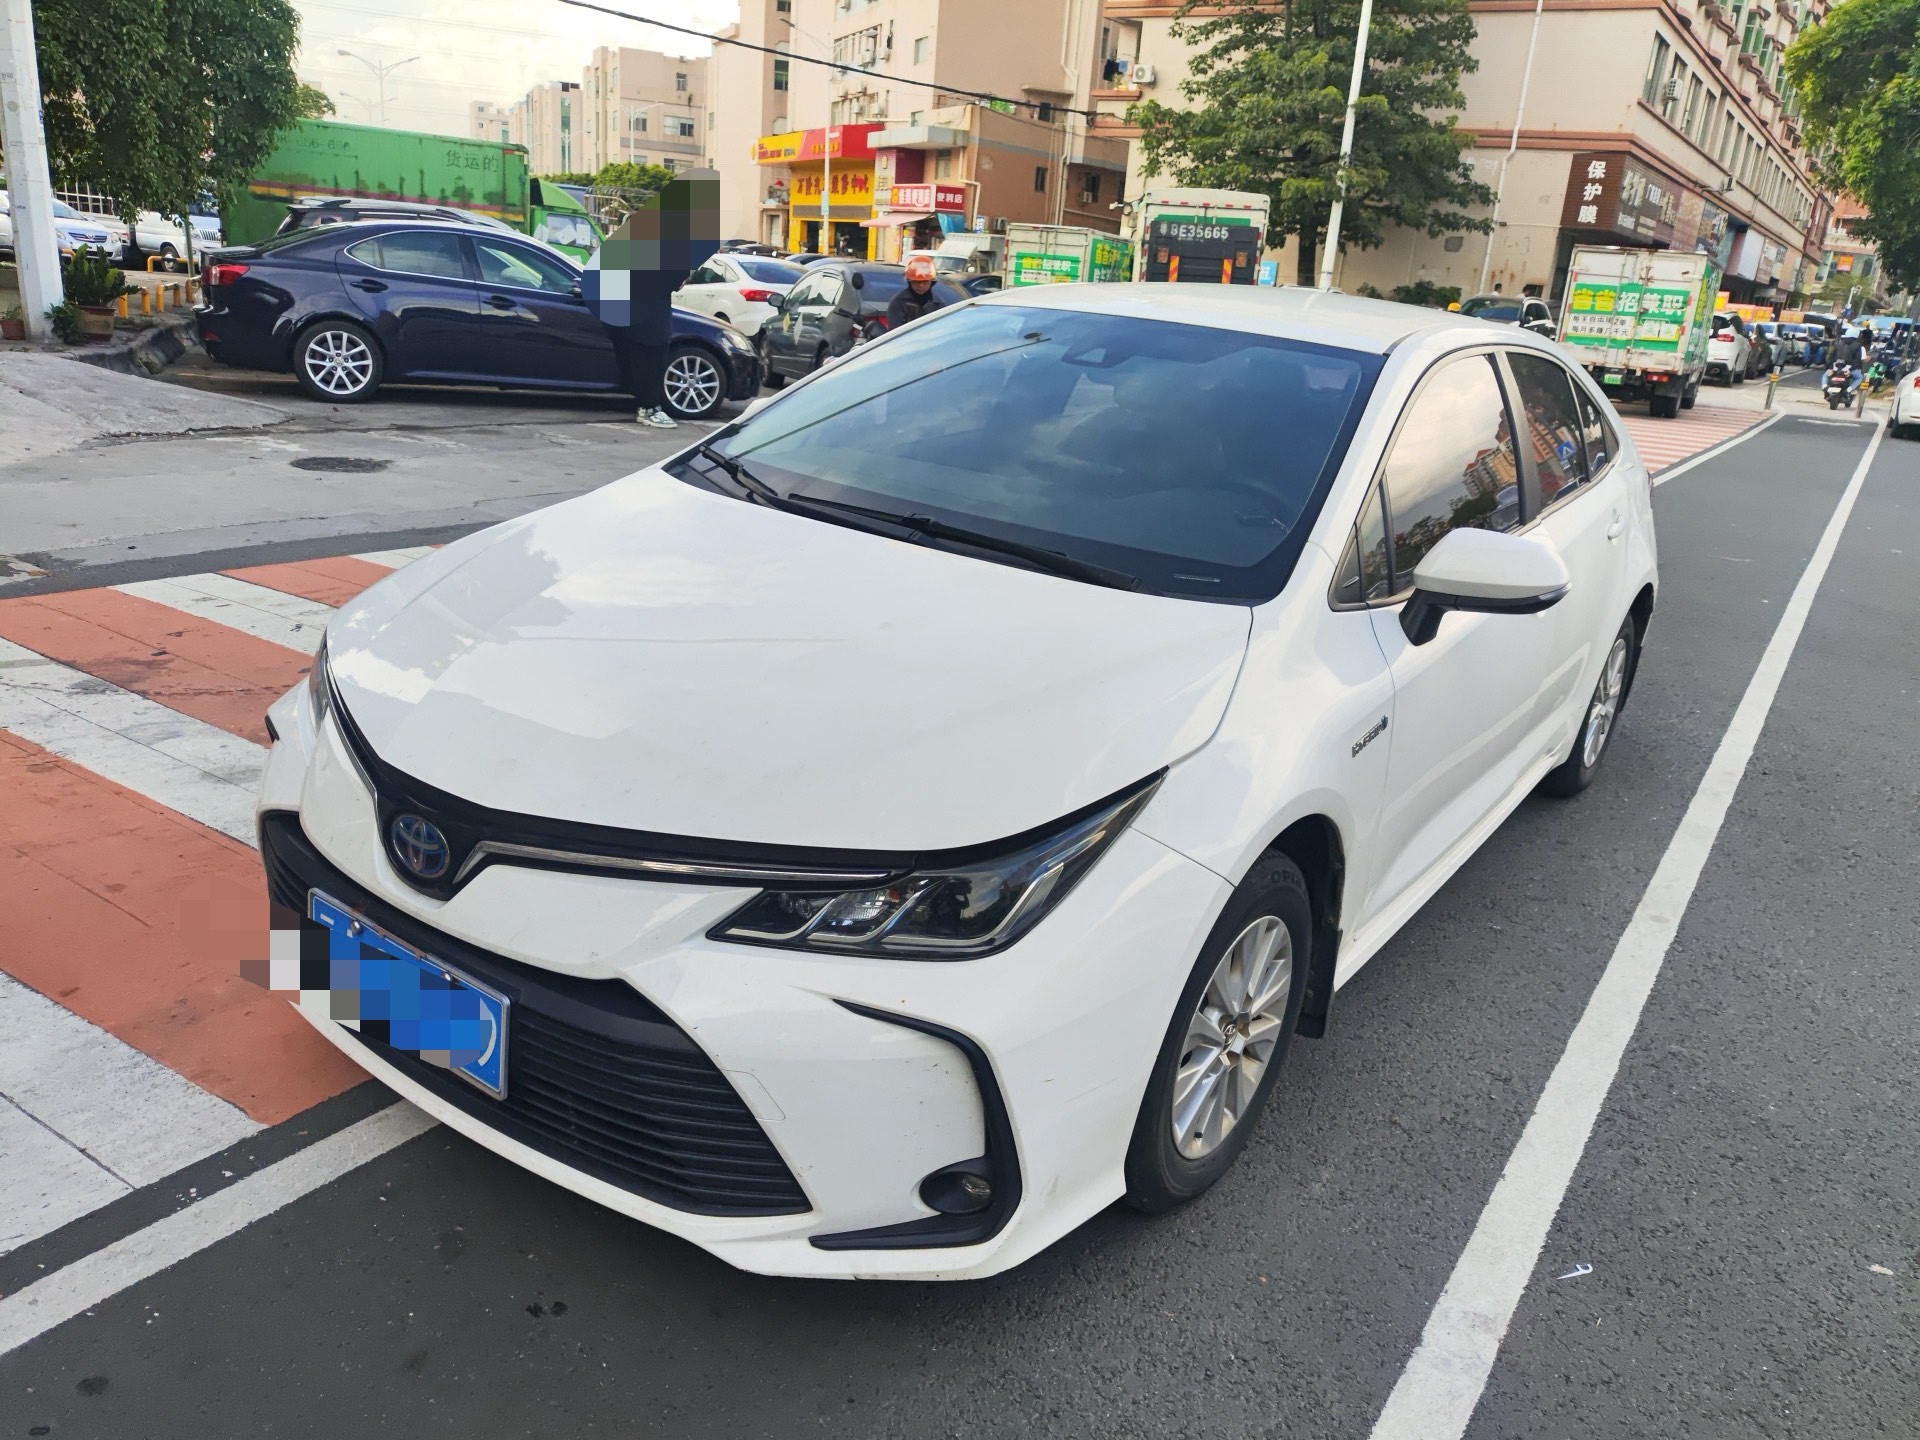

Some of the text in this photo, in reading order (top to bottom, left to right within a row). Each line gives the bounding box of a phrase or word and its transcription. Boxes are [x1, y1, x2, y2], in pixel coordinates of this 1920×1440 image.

[445, 149, 498, 173] 货运的
[936, 192, 964, 204] 便利店
[1577, 160, 1607, 224] 保护膜
[1573, 288, 1685, 316] 省省招兼职
